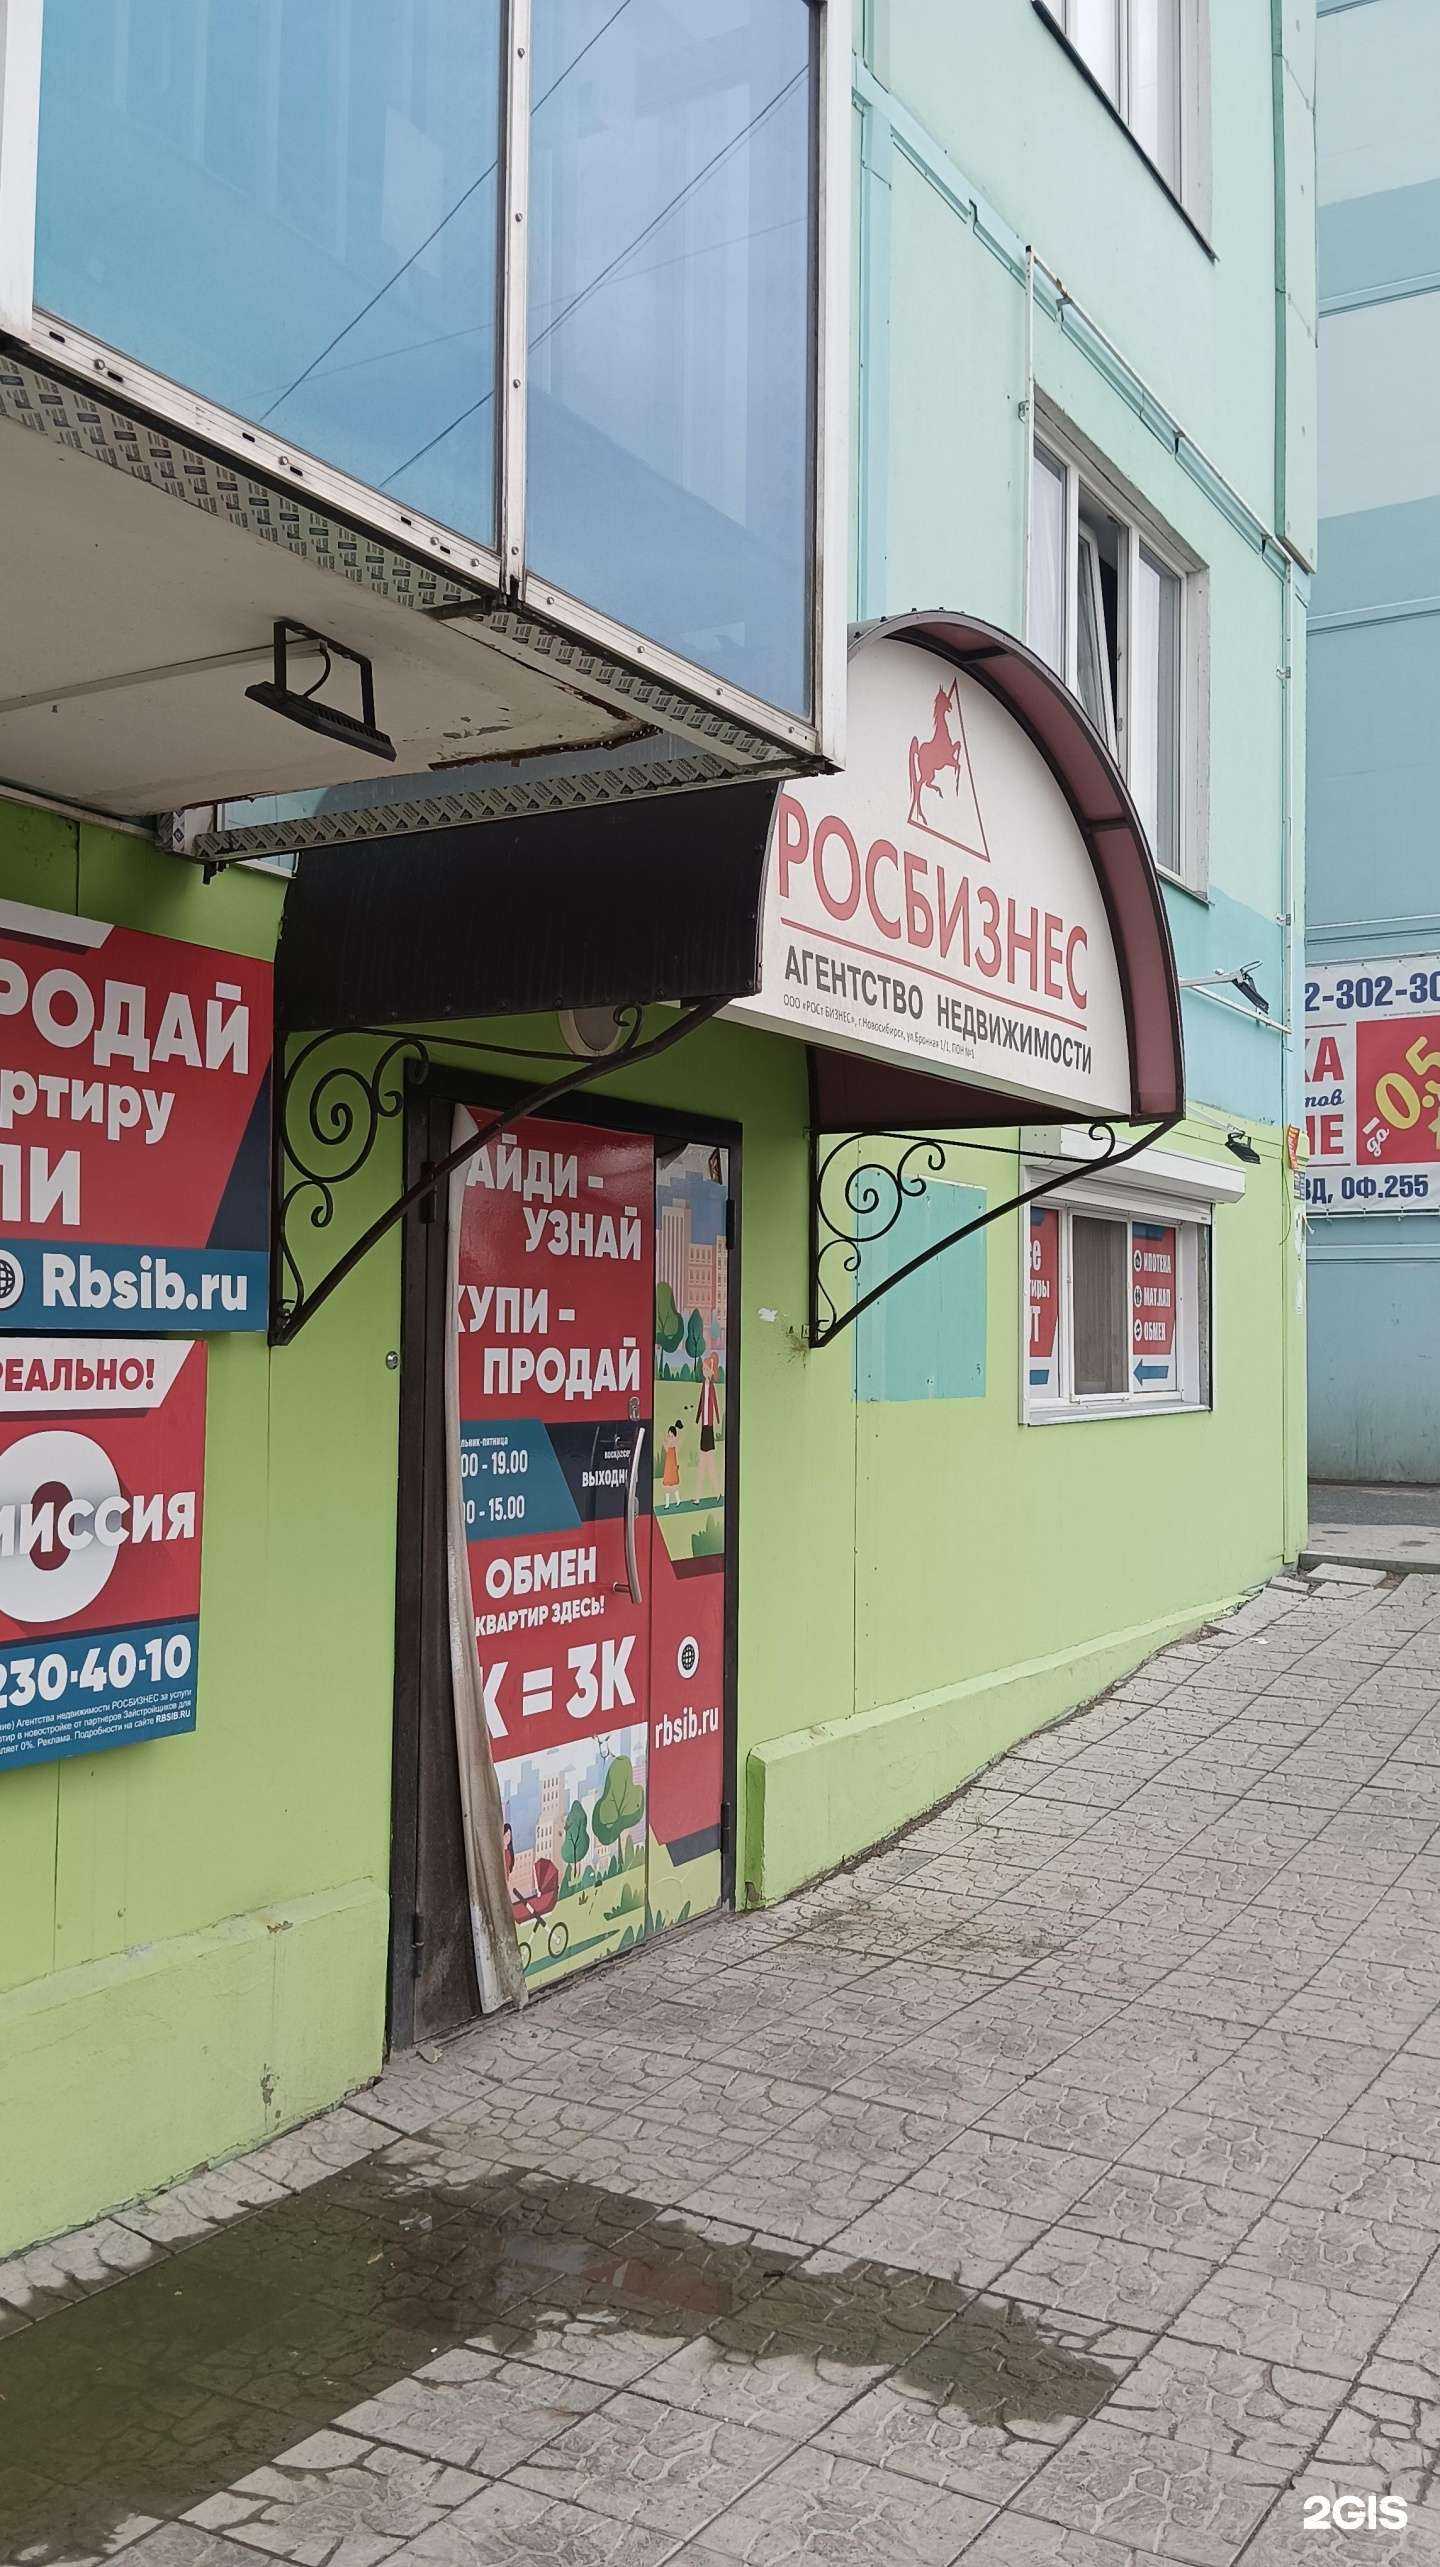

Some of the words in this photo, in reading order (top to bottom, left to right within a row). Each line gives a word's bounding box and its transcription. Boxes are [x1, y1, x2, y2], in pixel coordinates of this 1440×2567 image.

[778, 793, 1088, 1010] РОСБИЗНЕС
[783, 993, 801, 1009] ООО
[785, 944, 924, 1020] АГЕНТСТВО
[937, 994, 1092, 1075] НЕДВИЖИМОСТИ
[0, 1069, 175, 1144] ртиру
[1342, 1174, 1429, 1200] ОФ.255
[523, 1206, 642, 1261] УЗНАЙ
[1143, 1252, 1171, 1274] ИПОТЕКА
[41, 1252, 248, 1312] Rbsib.ru
[1143, 1321, 1166, 1342] ОБМЕН
[0, 1357, 155, 1393] ЕАЛЬНО!
[483, 1338, 641, 1401] ПРОДАЙ
[491, 1450, 528, 1475] 19.00
[582, 1468, 628, 1488] ВЫХОДН
[462, 1499, 476, 1524] 0
[488, 1494, 525, 1522] 15.00
[485, 1546, 597, 1600] ОБМЕН
[475, 1605, 549, 1637] КВАРТИР
[551, 1595, 605, 1625] ЗДЕСЬ!
[565, 1635, 637, 1720] 3К
[16, 1714, 55, 1728] Агентства
[56, 1704, 110, 1721] недвижимости
[111, 1693, 159, 1710] РОСБИЗНЕС
[24, 1722, 72, 1739] новостройке
[84, 1713, 122, 1727] партнеров
[74, 1724, 123, 1740] Подробности
[156, 1710, 191, 1724] RBSIB.RU
[655, 1706, 720, 1749] rbsib.ru
